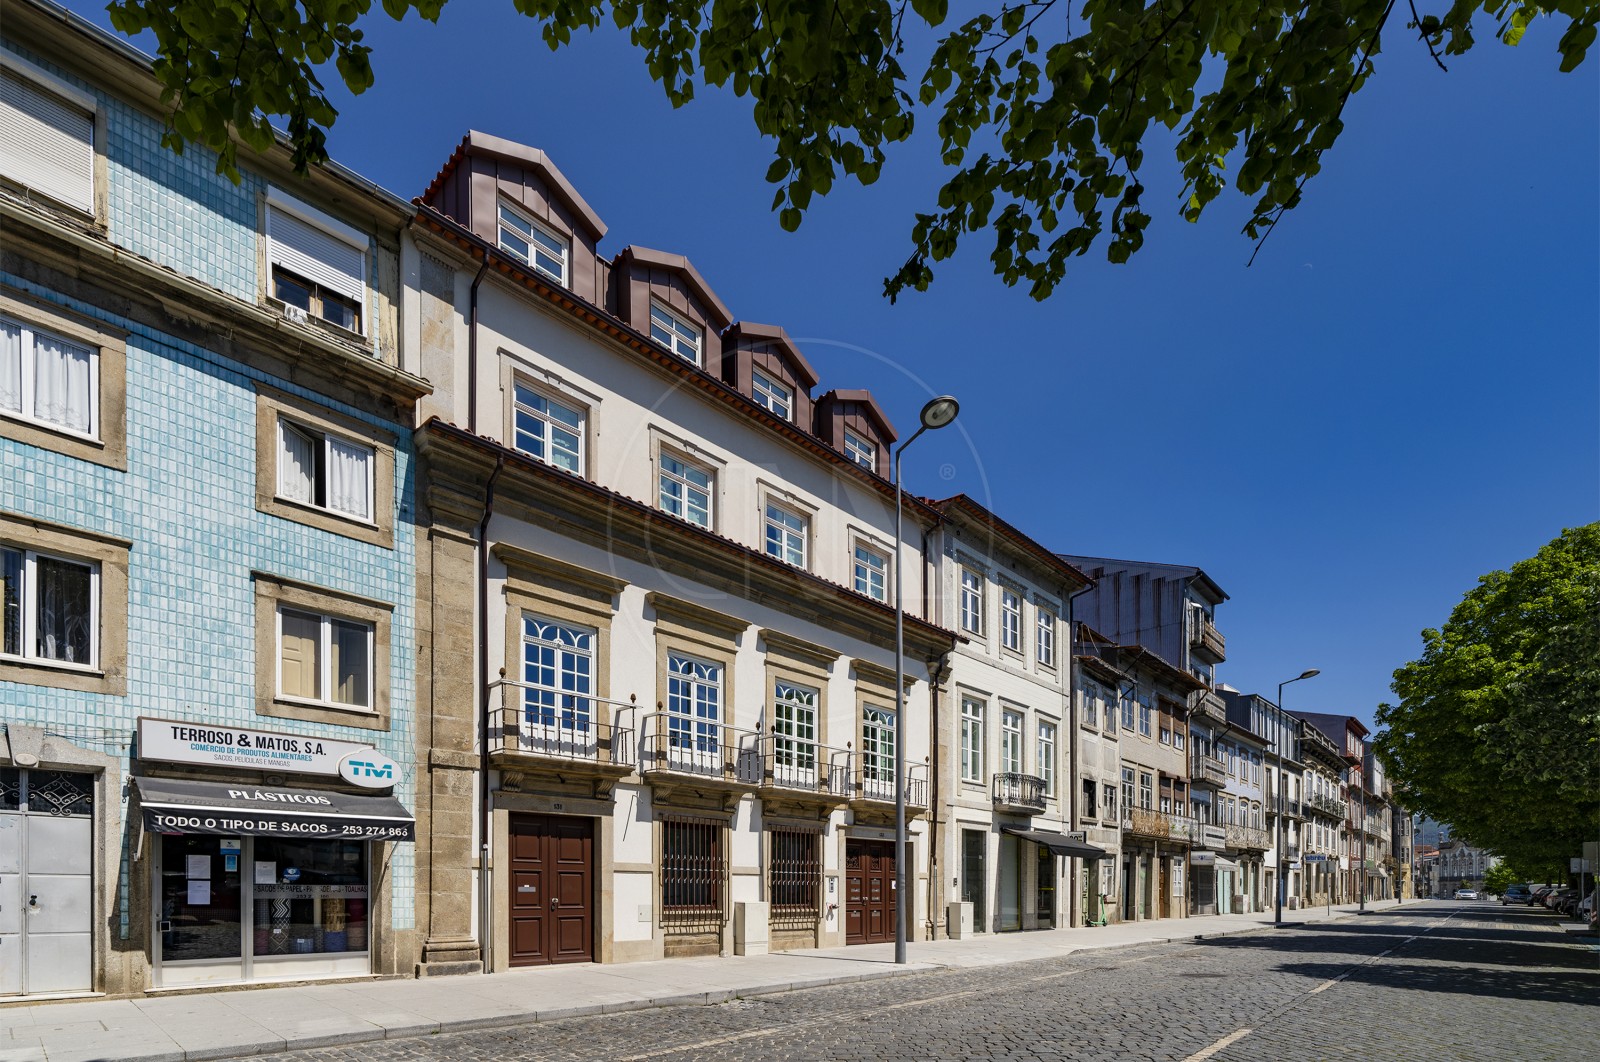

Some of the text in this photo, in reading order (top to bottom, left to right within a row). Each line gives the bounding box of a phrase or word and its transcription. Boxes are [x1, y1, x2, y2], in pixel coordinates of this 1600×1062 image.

[171, 726, 327, 756] TERROSO & MATOS, S.A.
[190, 742, 313, 762] COMÉRCIO DE PRODUTOS ALIMENTARES
[268, 759, 291, 767] MANGAS
[348, 760, 393, 779] TM
[228, 789, 332, 805] PLÁSTICOS
[155, 815, 200, 828] TODO
[204, 818, 216, 828] O
[220, 819, 254, 830] TIPO
[258, 821, 277, 831] DE
[281, 822, 328, 833] SACOS
[342, 825, 363, 835] 253
[365, 826, 385, 836] 274
[257, 885, 276, 893] SACOS
[345, 885, 368, 893] TOALHAS
